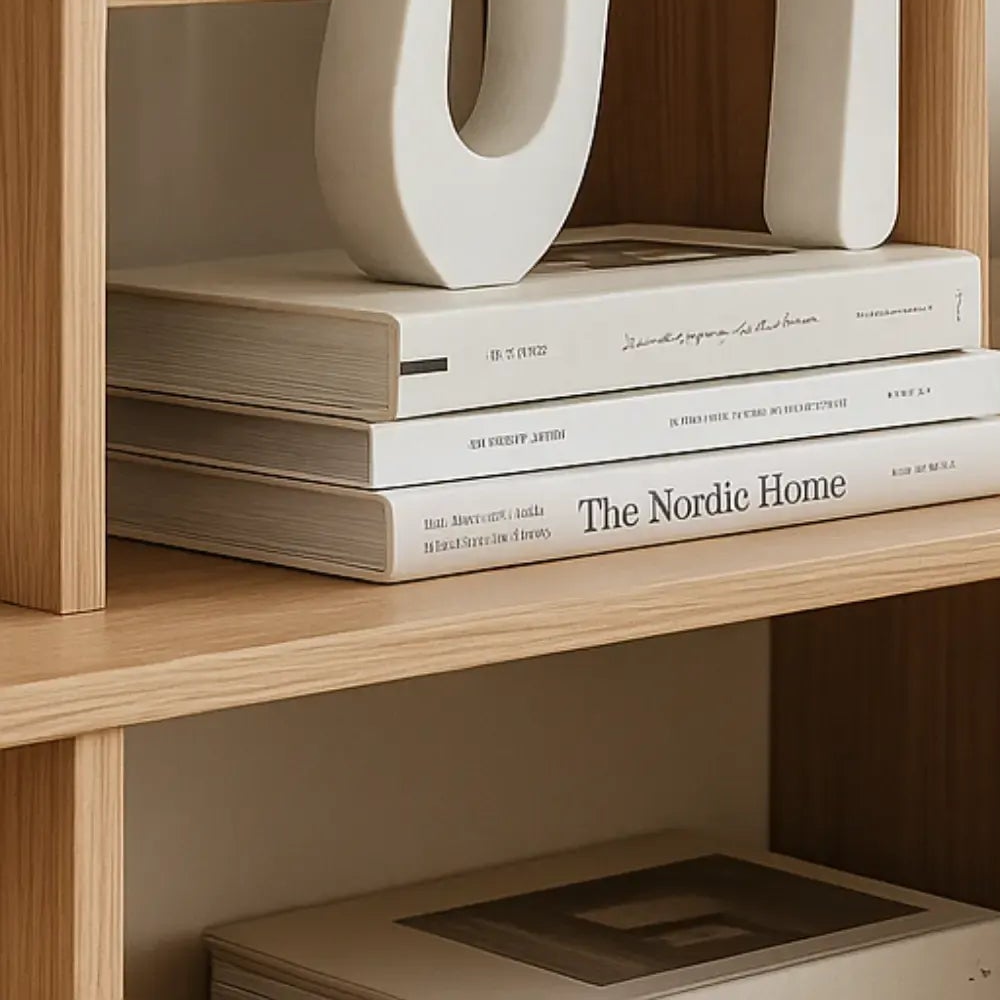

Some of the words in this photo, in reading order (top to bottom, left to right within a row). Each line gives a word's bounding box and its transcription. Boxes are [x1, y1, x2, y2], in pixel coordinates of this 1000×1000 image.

[578, 496, 640, 534] The
[648, 481, 750, 524] Nordic
[757, 472, 847, 509] Home
